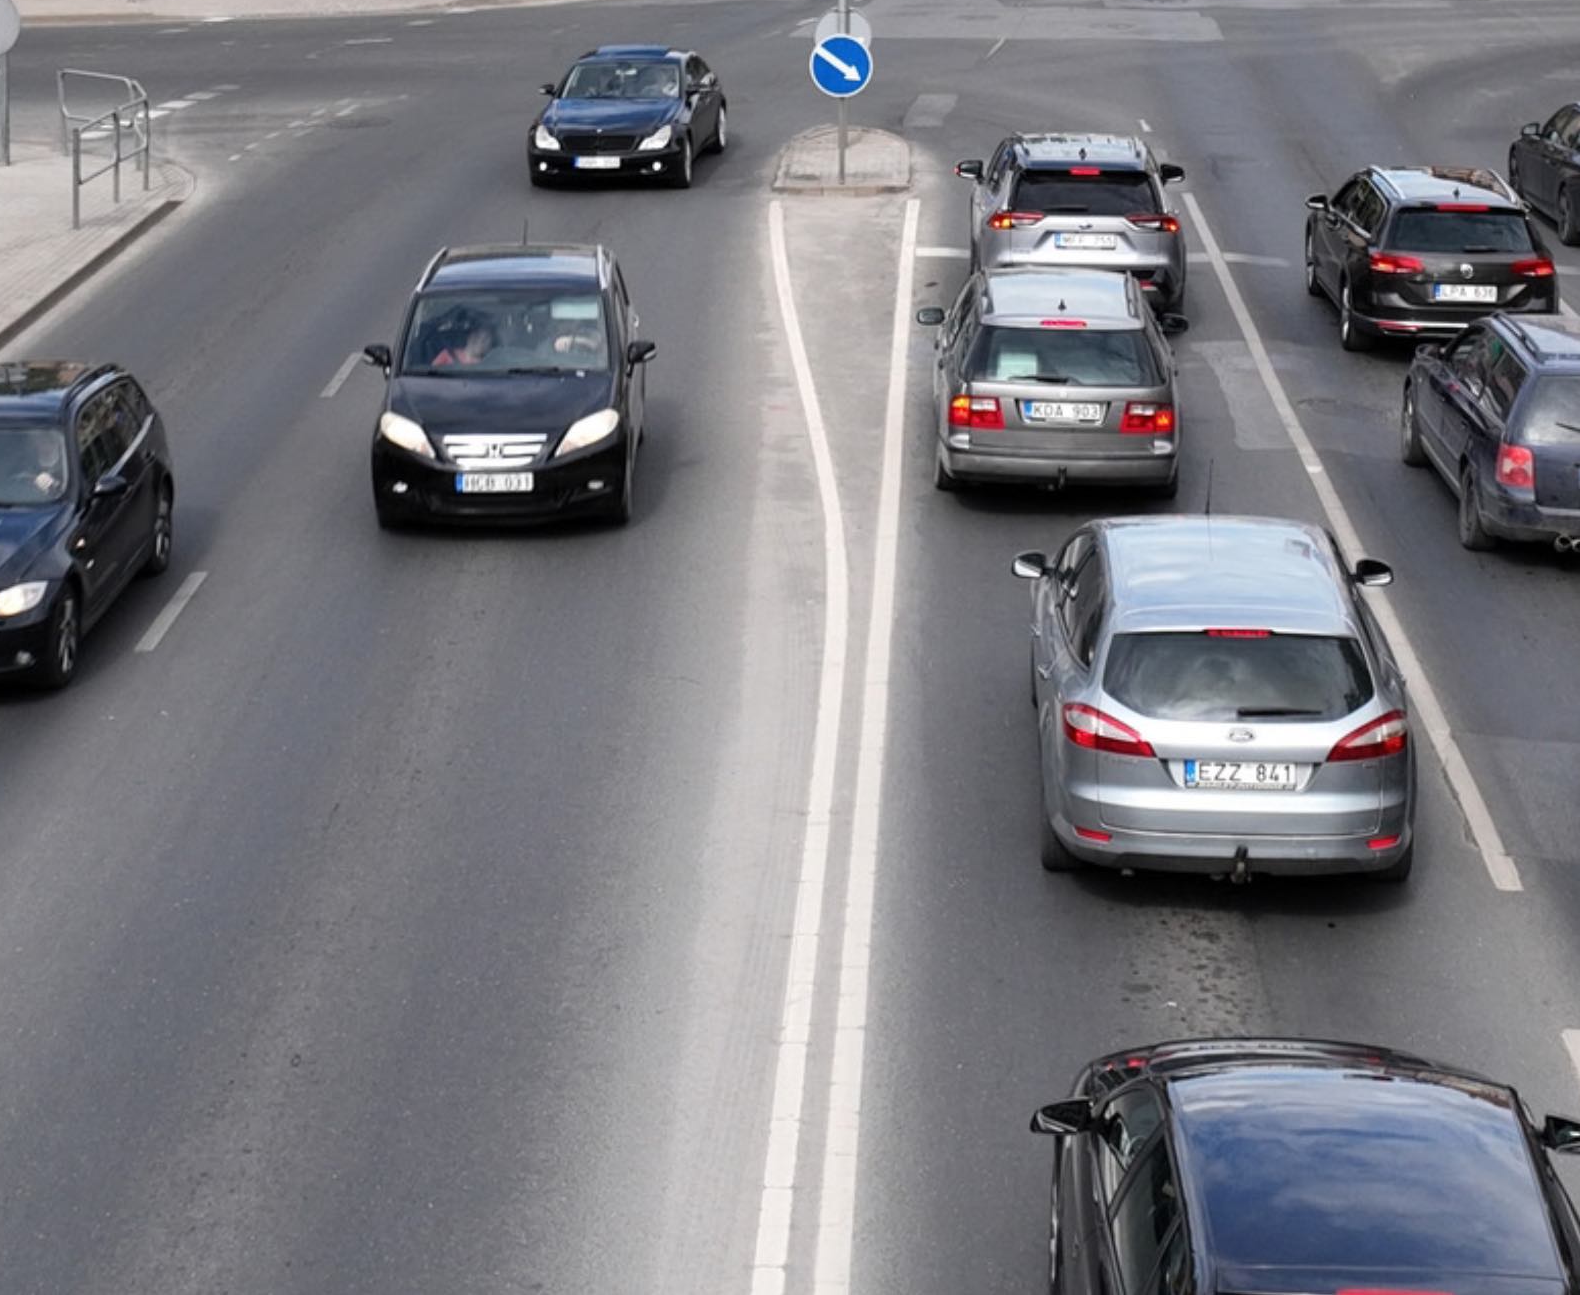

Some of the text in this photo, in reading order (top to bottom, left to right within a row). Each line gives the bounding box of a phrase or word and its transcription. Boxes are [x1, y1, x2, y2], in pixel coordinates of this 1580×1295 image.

[1072, 406, 1099, 418] 903
[1199, 763, 1290, 782] EZZ 841
